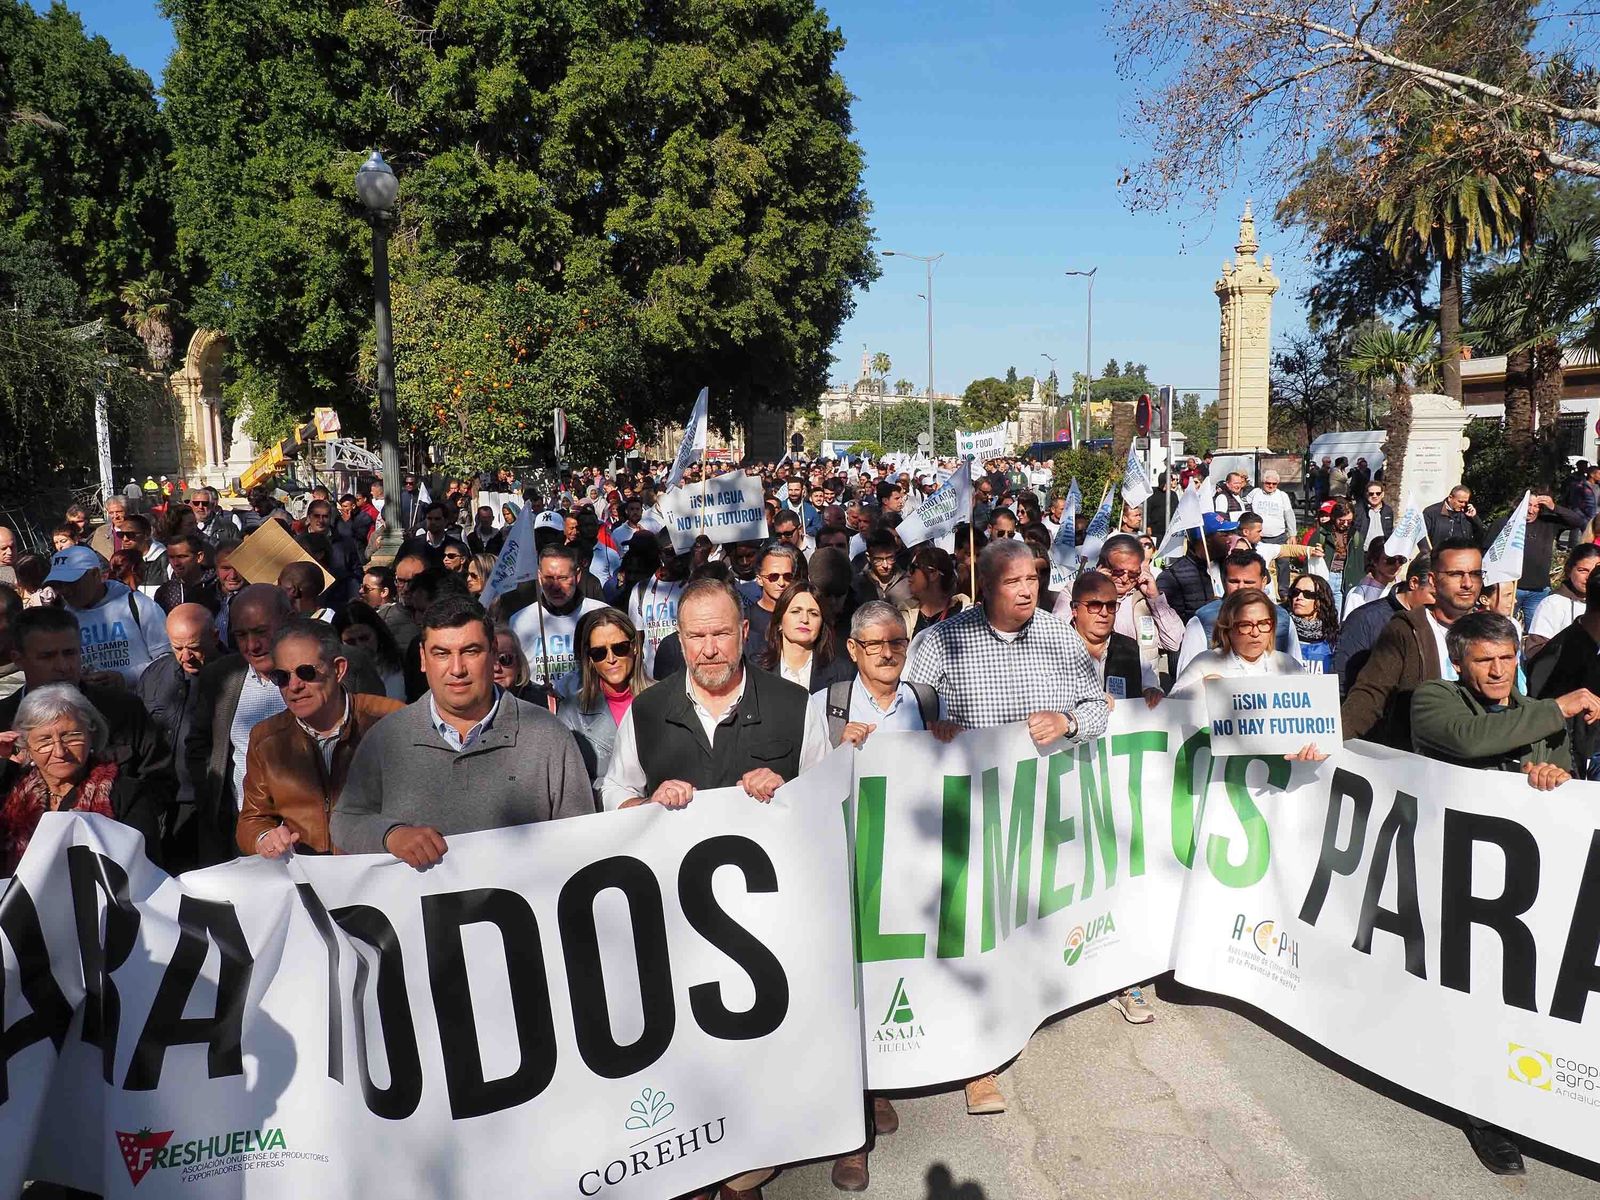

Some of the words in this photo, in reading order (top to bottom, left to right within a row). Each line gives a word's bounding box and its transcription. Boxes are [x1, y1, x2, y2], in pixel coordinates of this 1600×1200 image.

[976, 438, 993, 449] FOOD
[977, 448, 1002, 460] UTURE
[718, 490, 745, 506] AGUA
[677, 516, 692, 532] NO
[695, 513, 714, 529] HAY
[717, 507, 762, 526] FUTURO!!
[53, 556, 69, 566] NY
[97, 640, 129, 651] CAMPO
[556, 654, 566, 662] EL
[536, 661, 576, 673] AIMEN
[1272, 692, 1311, 709] AGUA
[1213, 719, 1233, 735] NO
[1237, 718, 1265, 735] HAY
[1270, 717, 1335, 734] FUTURO!!
[842, 727, 1291, 1009] LIMENTOS
[1086, 911, 1116, 942] UPA
[872, 1024, 925, 1041] ASAJA
[879, 1040, 920, 1053] HUELVA
[136, 1128, 287, 1171] FRESHUELVA
[578, 1117, 726, 1197] COREHU
[227, 1152, 267, 1165] ONUBENSE
[269, 1151, 279, 1160] DE
[280, 1151, 329, 1163] PRODUCTORES
[188, 1163, 243, 1182] EXPORTADORES
[244, 1161, 255, 1170] DE
[256, 1160, 286, 1169] FRESAS
